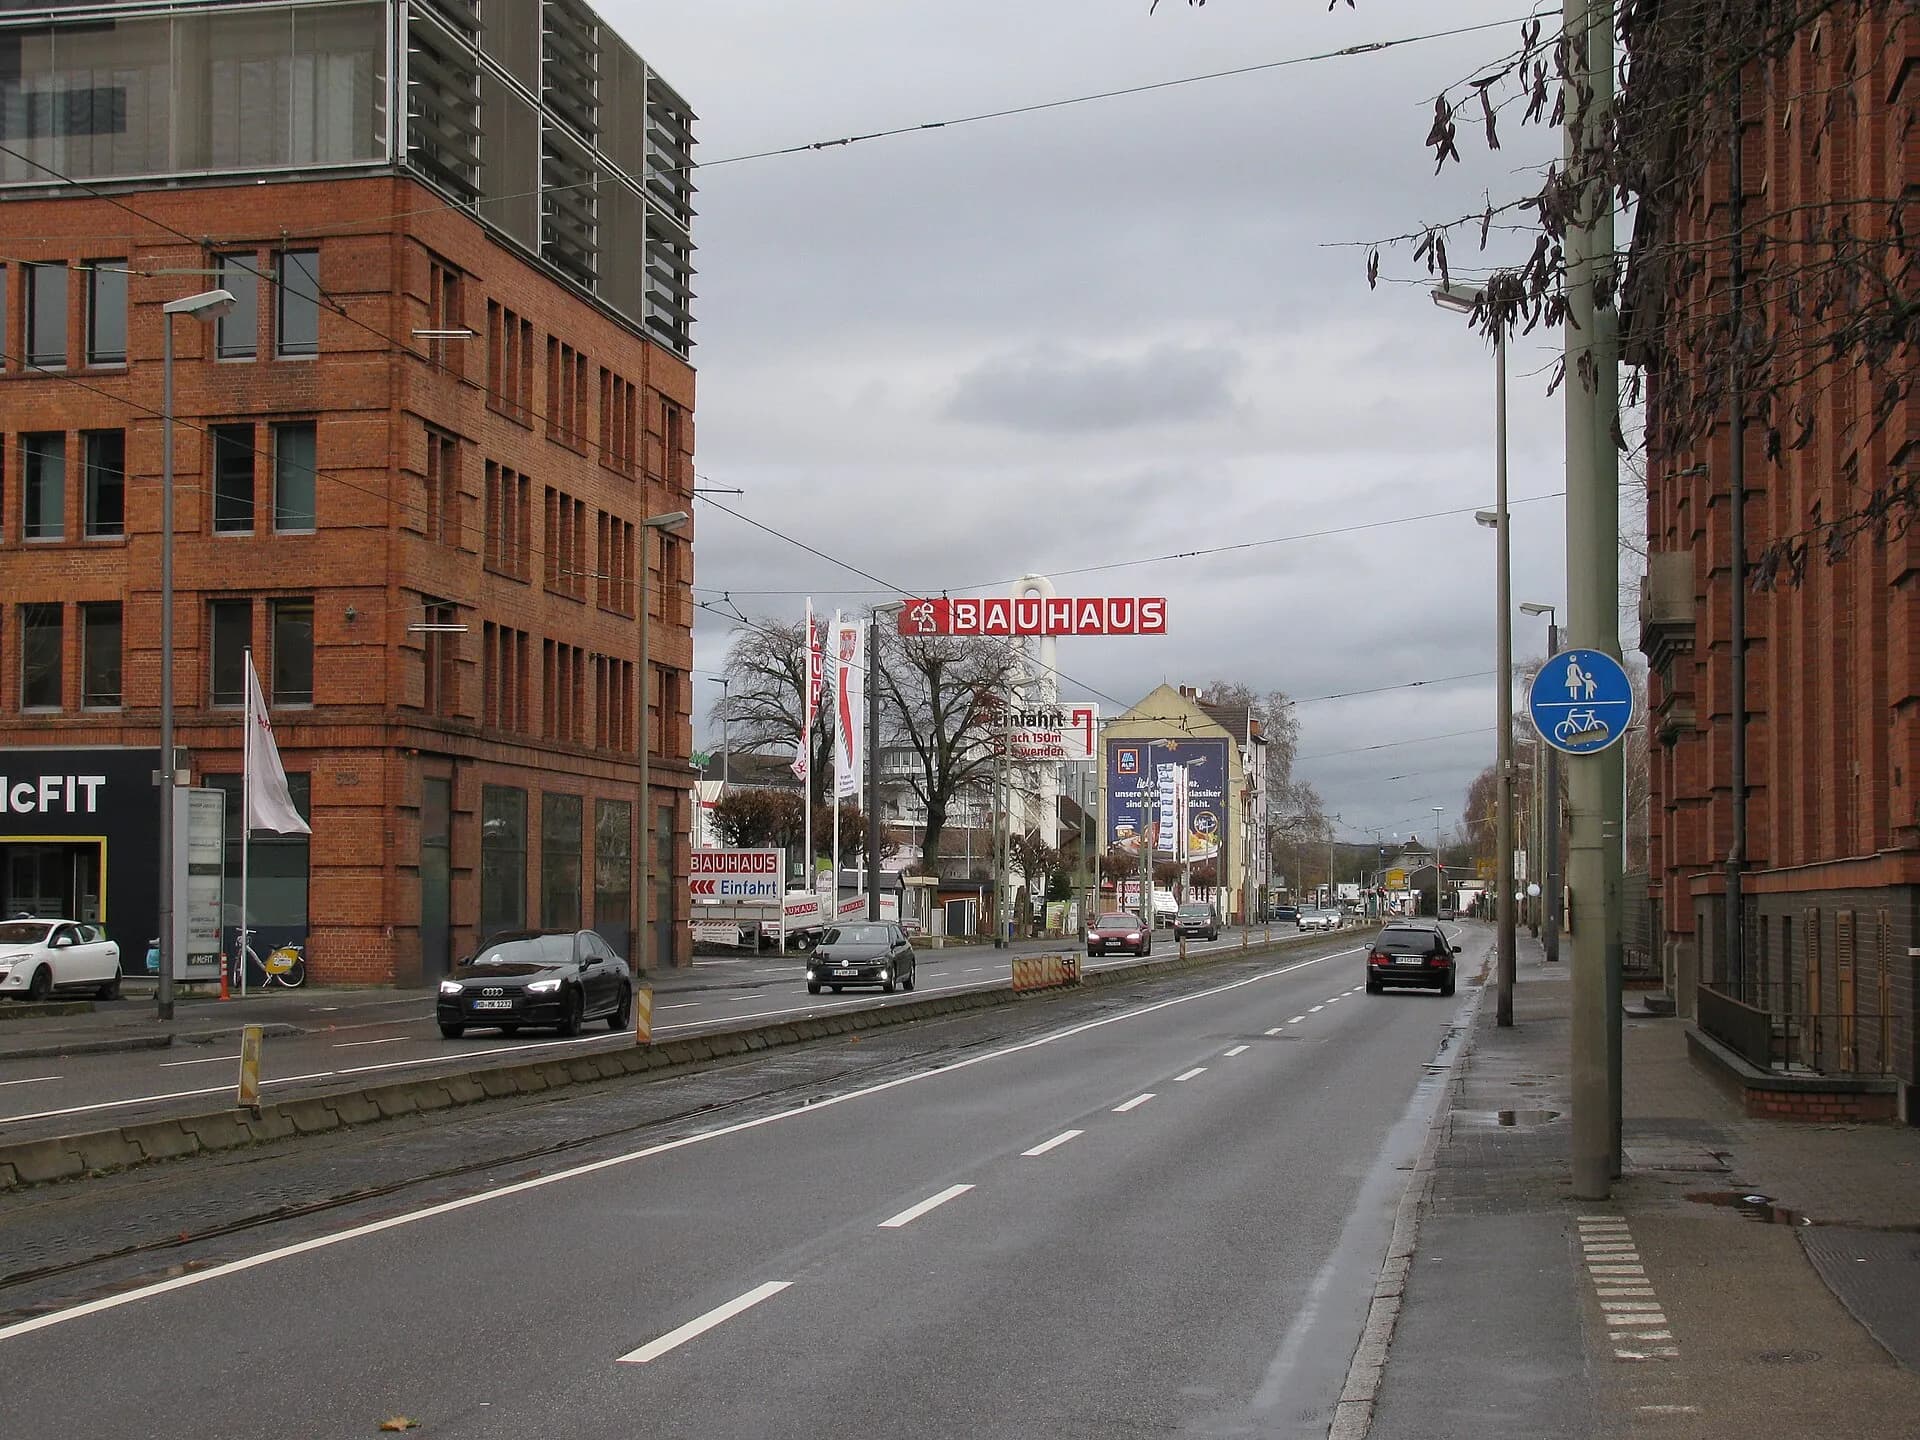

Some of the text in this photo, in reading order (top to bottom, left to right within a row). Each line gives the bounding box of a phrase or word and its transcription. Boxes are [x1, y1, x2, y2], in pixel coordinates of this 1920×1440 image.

[957, 603, 1163, 629] BAUHAUS
[1032, 731, 1062, 743] 150m
[1125, 799, 1142, 808] sind
[691, 855, 776, 871] BAUHAUS
[720, 880, 777, 895] Einfahrt
